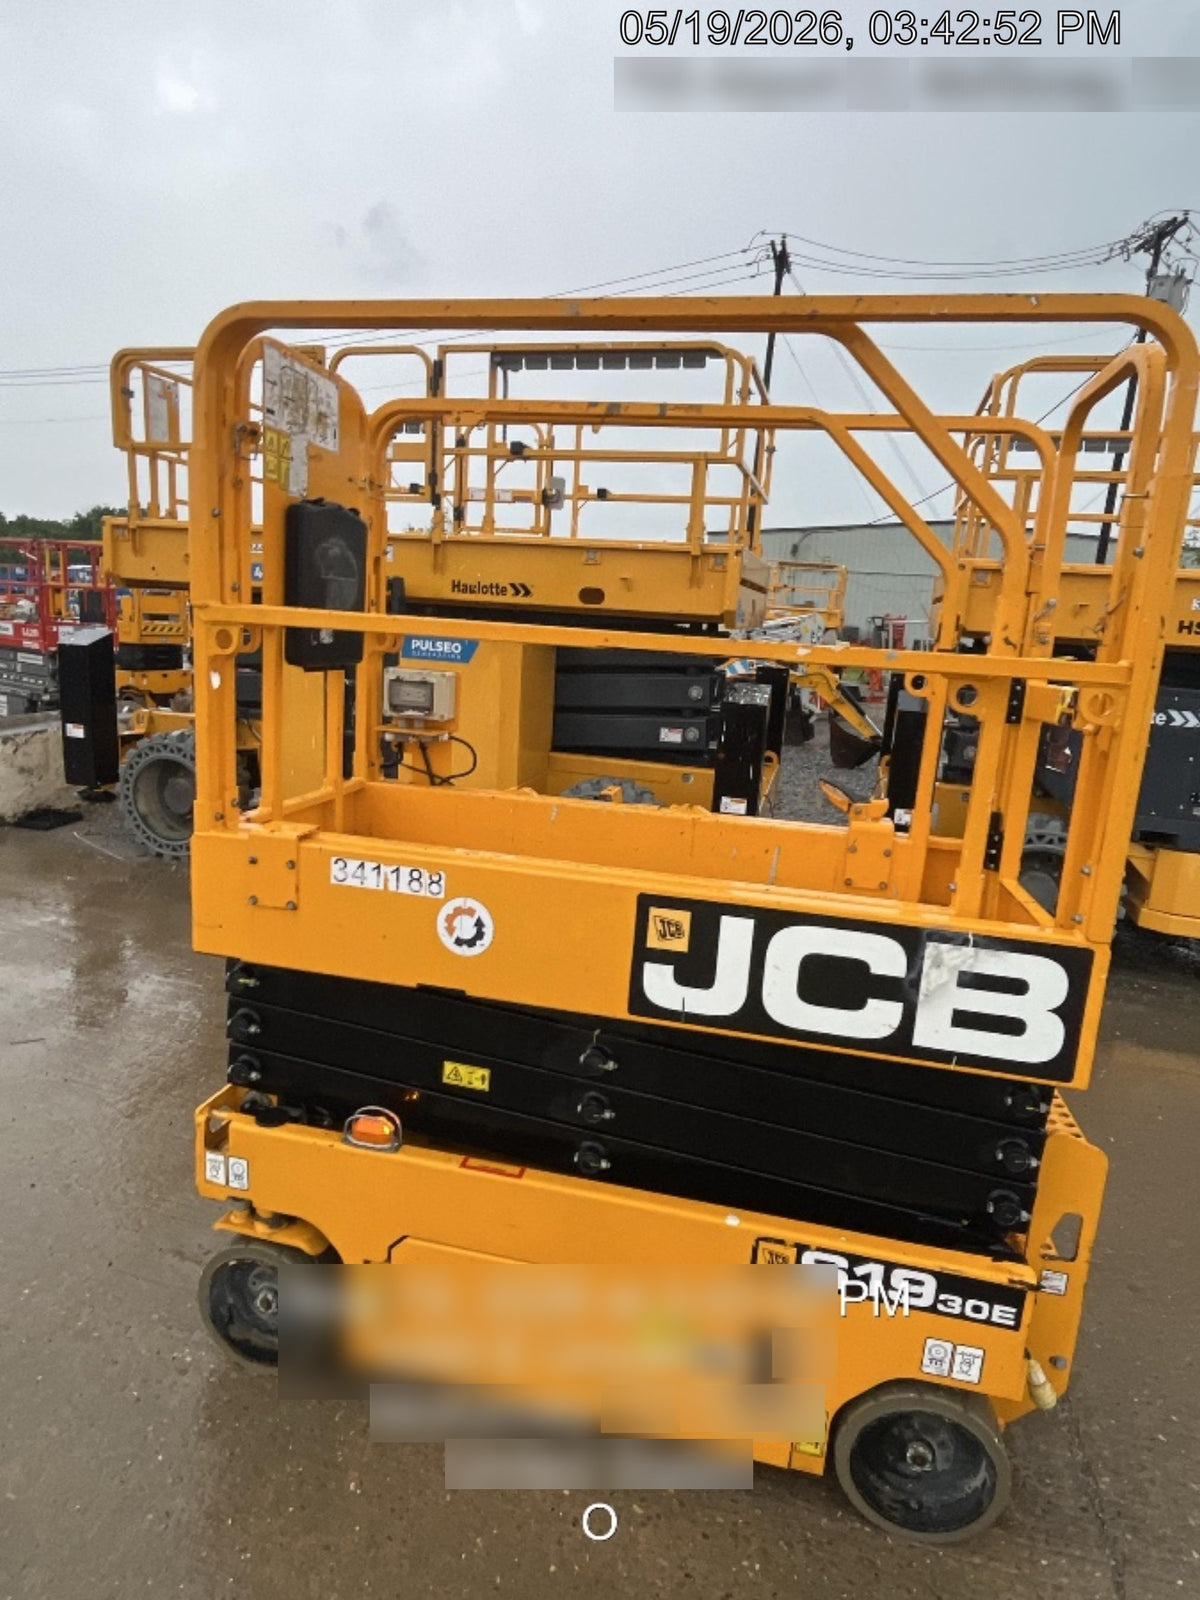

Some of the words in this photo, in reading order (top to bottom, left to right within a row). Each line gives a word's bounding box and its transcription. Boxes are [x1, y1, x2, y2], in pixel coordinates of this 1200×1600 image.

[451, 579, 508, 596] Haulotte
[411, 639, 462, 654] PULSEO
[332, 857, 443, 896] 341188
[643, 914, 1070, 1065] JCB
